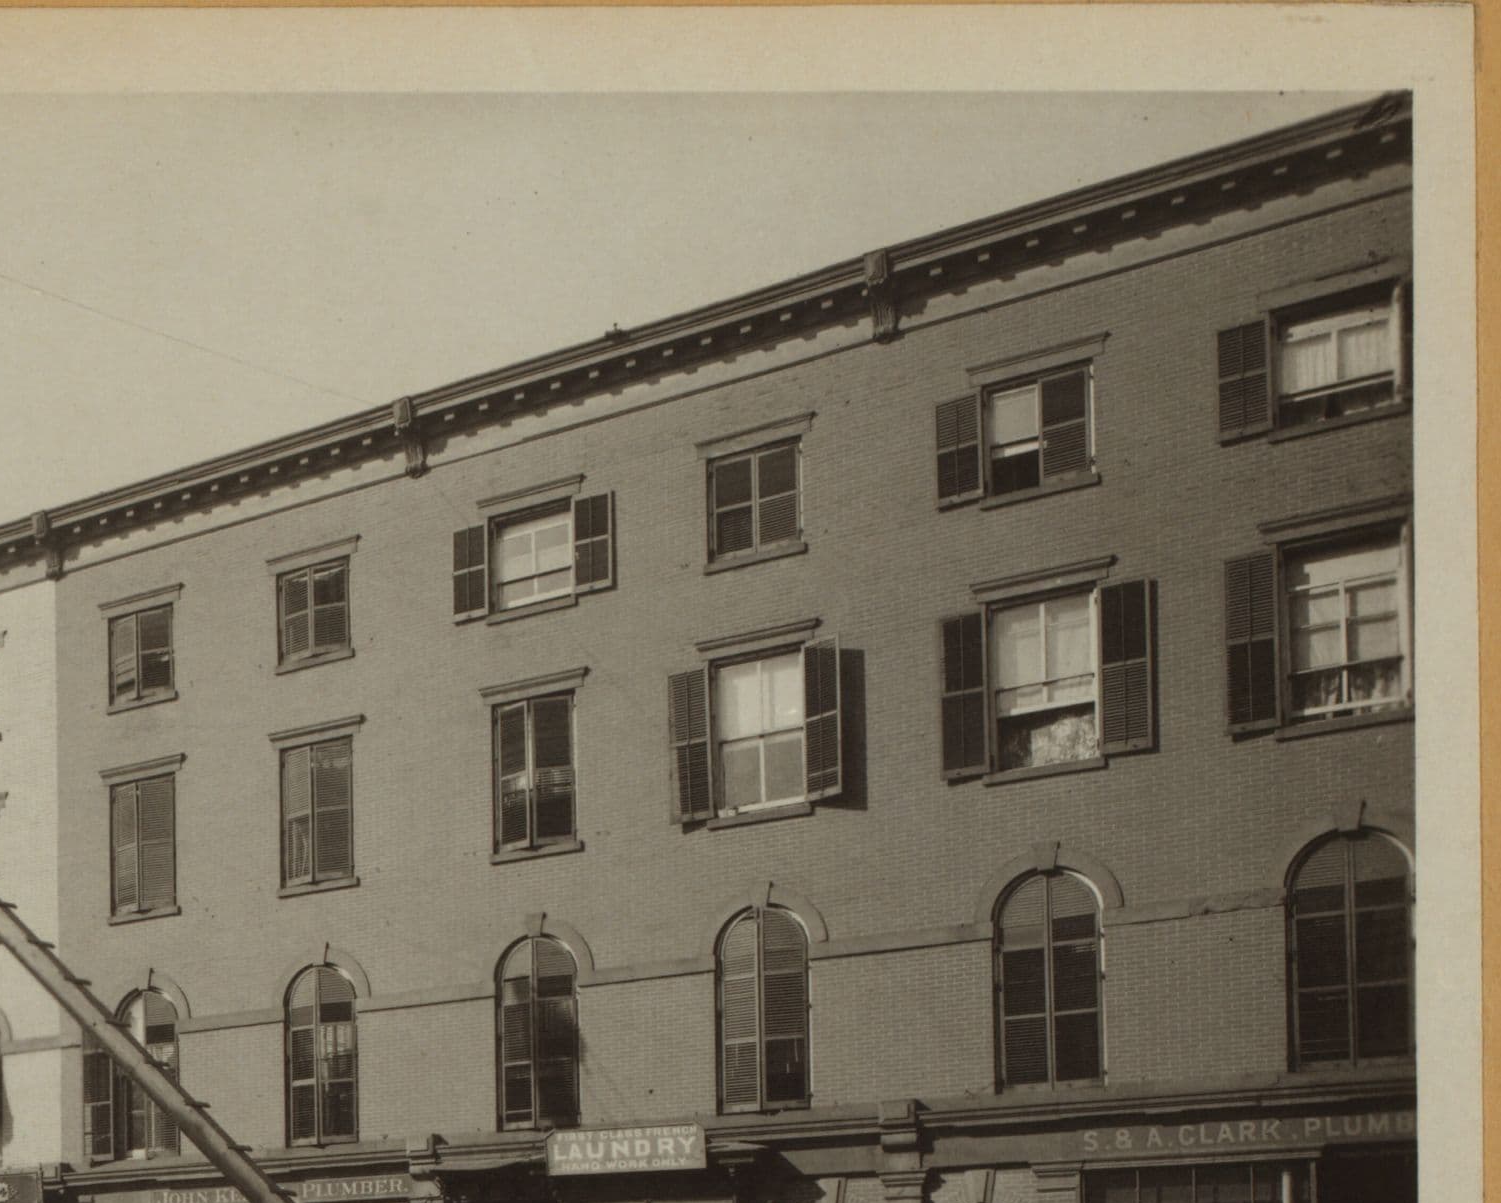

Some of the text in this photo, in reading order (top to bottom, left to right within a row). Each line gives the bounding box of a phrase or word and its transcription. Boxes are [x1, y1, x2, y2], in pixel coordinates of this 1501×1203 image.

[556, 1125, 698, 1142] FIRST CLASS FRENCH
[552, 1136, 697, 1161] LAUNDRY
[606, 1159, 648, 1169] WORK
[652, 1157, 687, 1167] ONLY
